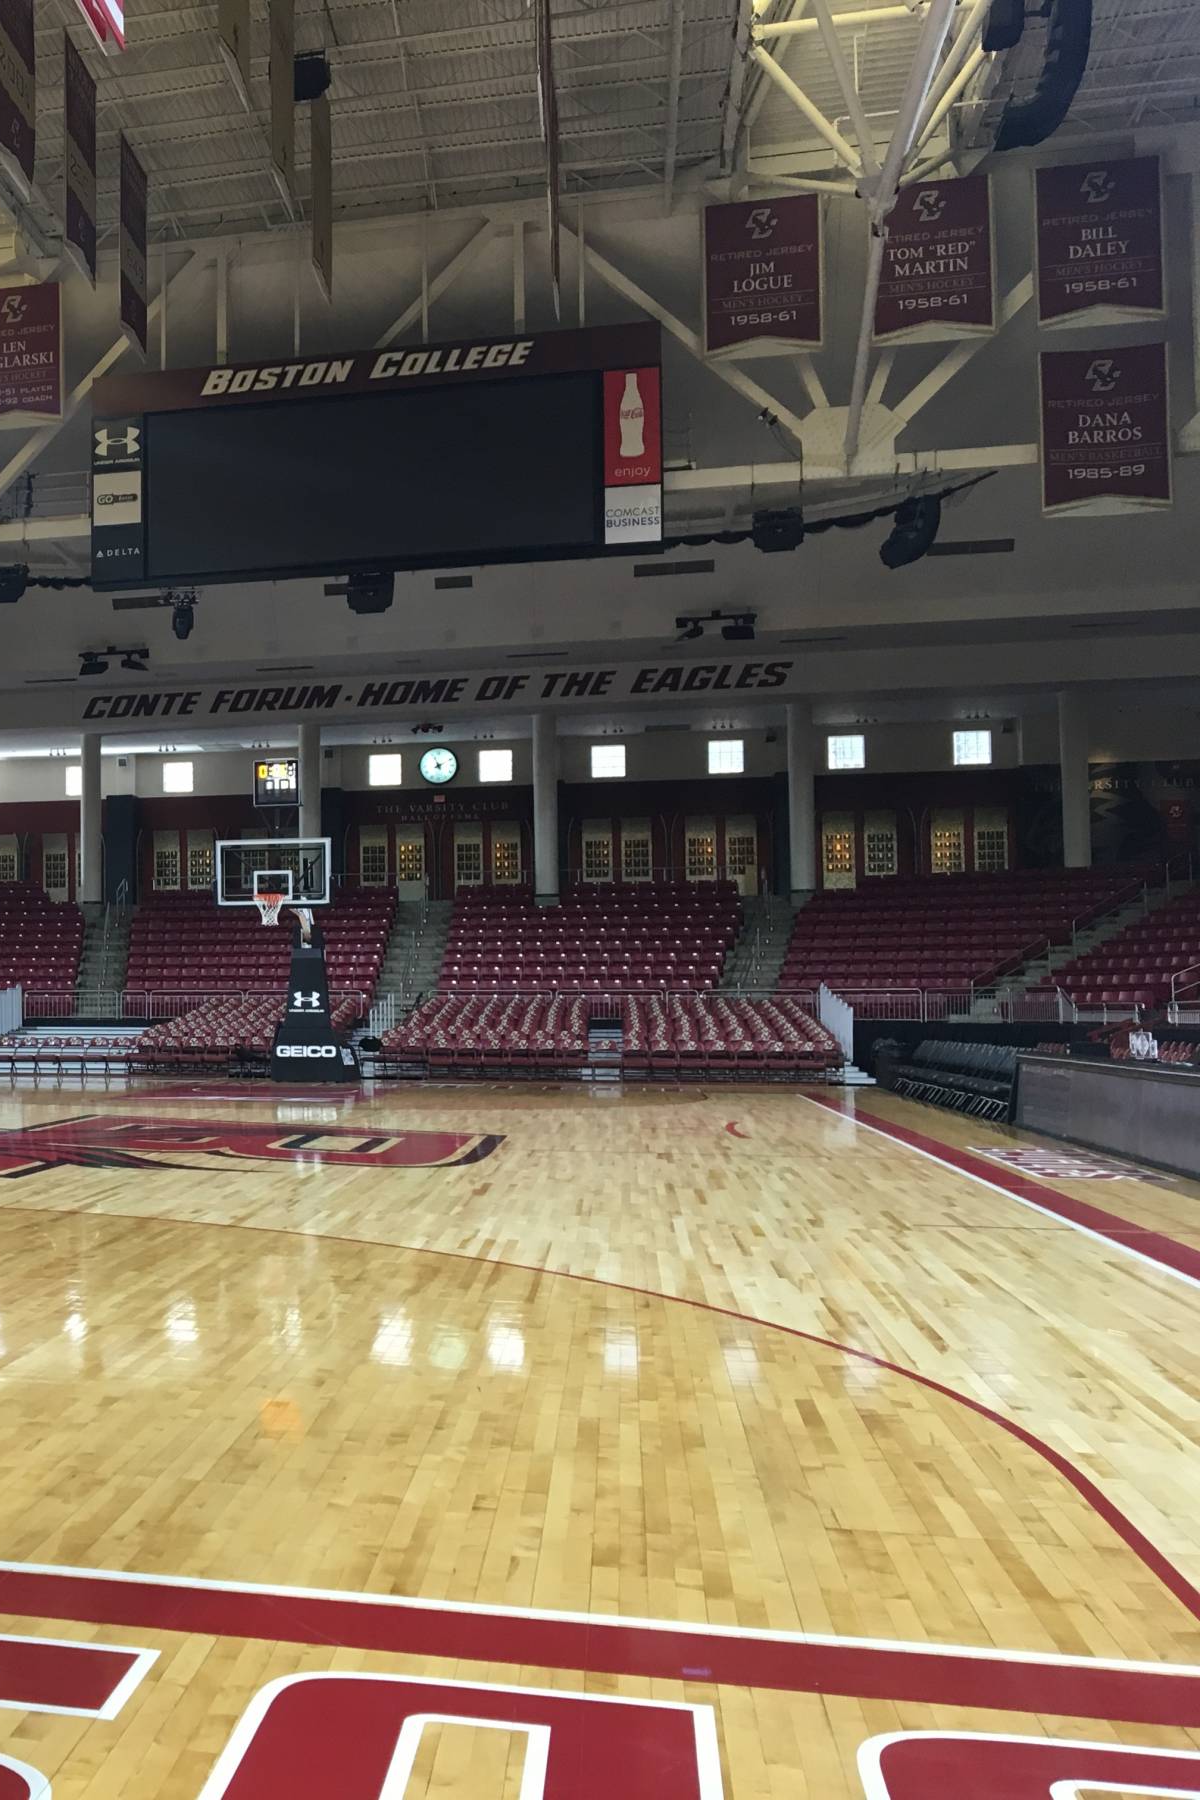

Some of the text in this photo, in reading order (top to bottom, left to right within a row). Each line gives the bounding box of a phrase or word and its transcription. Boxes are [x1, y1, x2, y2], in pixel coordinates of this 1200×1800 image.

[1042, 208, 1152, 227] RETIRED JERSEY
[887, 225, 984, 243] ETIRED JERSEY
[1081, 226, 1118, 241] BILL
[710, 243, 814, 262] RETIRED JERSEY
[887, 246, 924, 261] TOM
[1069, 240, 1130, 259] DALEY
[750, 261, 775, 277] JIM
[895, 257, 969, 277] MARTIN
[733, 274, 793, 293] LOGUE
[1064, 276, 1137, 294] 1958-61
[898, 294, 968, 311] 1958-61
[730, 310, 798, 327] 1958-61
[18, 324, 55, 335] JERSEY
[3, 340, 26, 353] LEN
[200, 340, 534, 396] BOSTON COLLEGE
[20, 385, 52, 393] PLAYER
[22, 395, 52, 403] COACH
[1078, 411, 1132, 428] DANA
[1068, 426, 1143, 444] BARROS
[614, 466, 651, 478] enjoy
[1067, 464, 1145, 480] 1985-89
[606, 506, 659, 518] COMCAST
[606, 516, 660, 528] BUSINESS
[107, 547, 140, 557] DELTA
[83, 661, 793, 720] CONTE FORUM HOME OF THE EAGLES
[276, 1045, 337, 1058] GEICO
